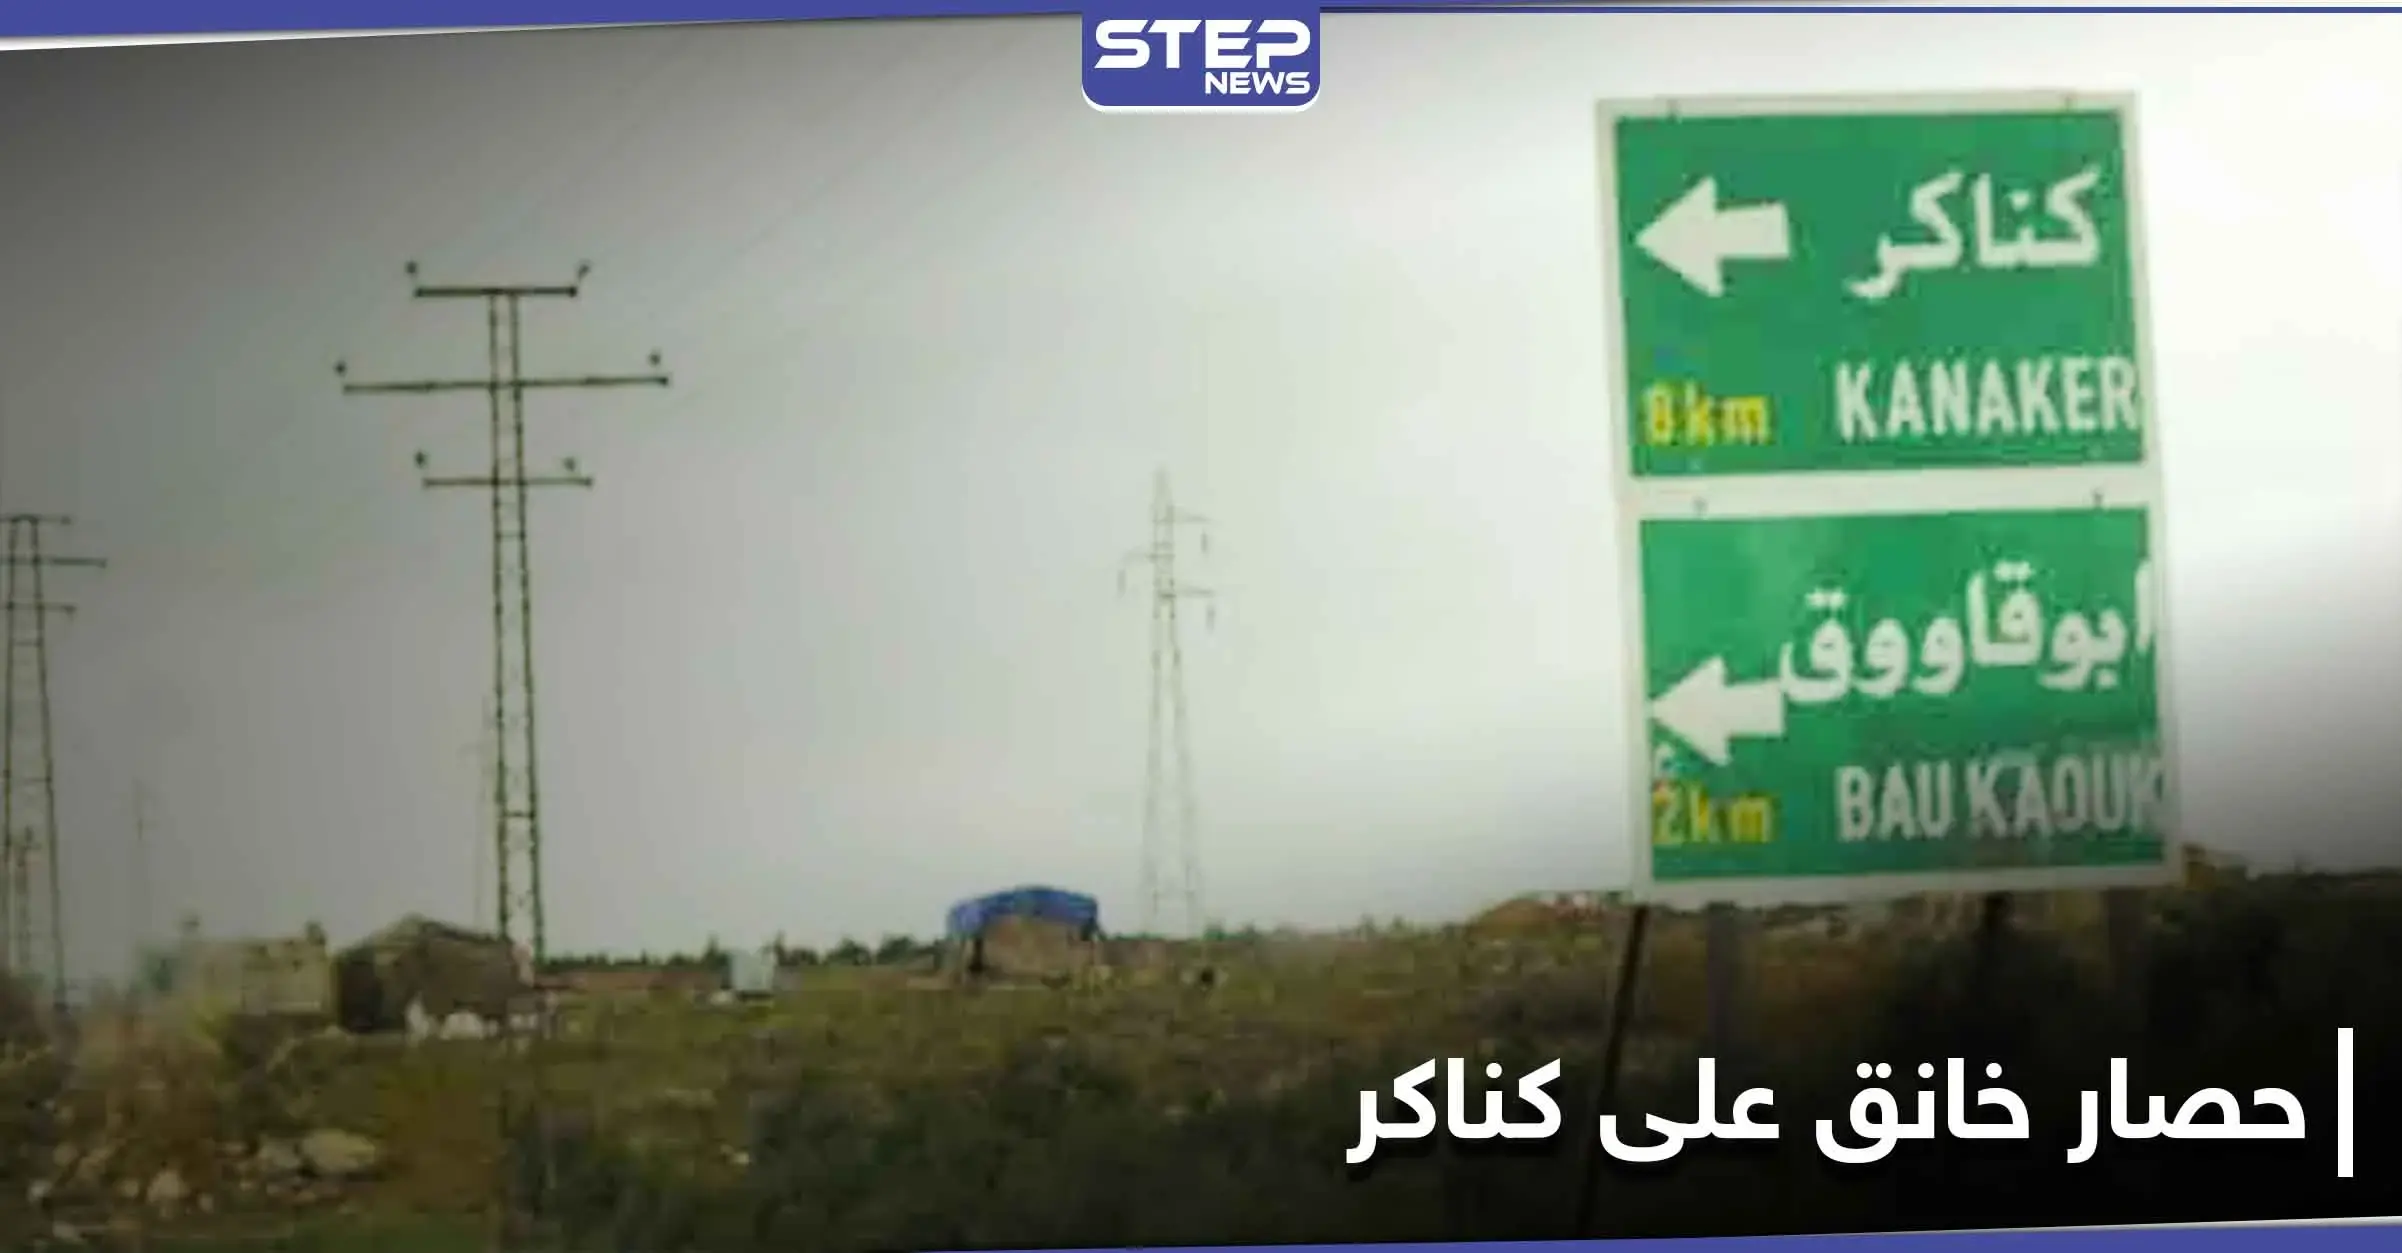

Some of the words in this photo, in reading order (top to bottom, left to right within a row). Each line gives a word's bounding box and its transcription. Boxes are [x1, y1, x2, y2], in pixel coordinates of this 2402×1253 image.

[1845, 165, 2101, 301] كناكر
[1835, 355, 2140, 440] KANAKER
[1835, 764, 1952, 842] BAU
